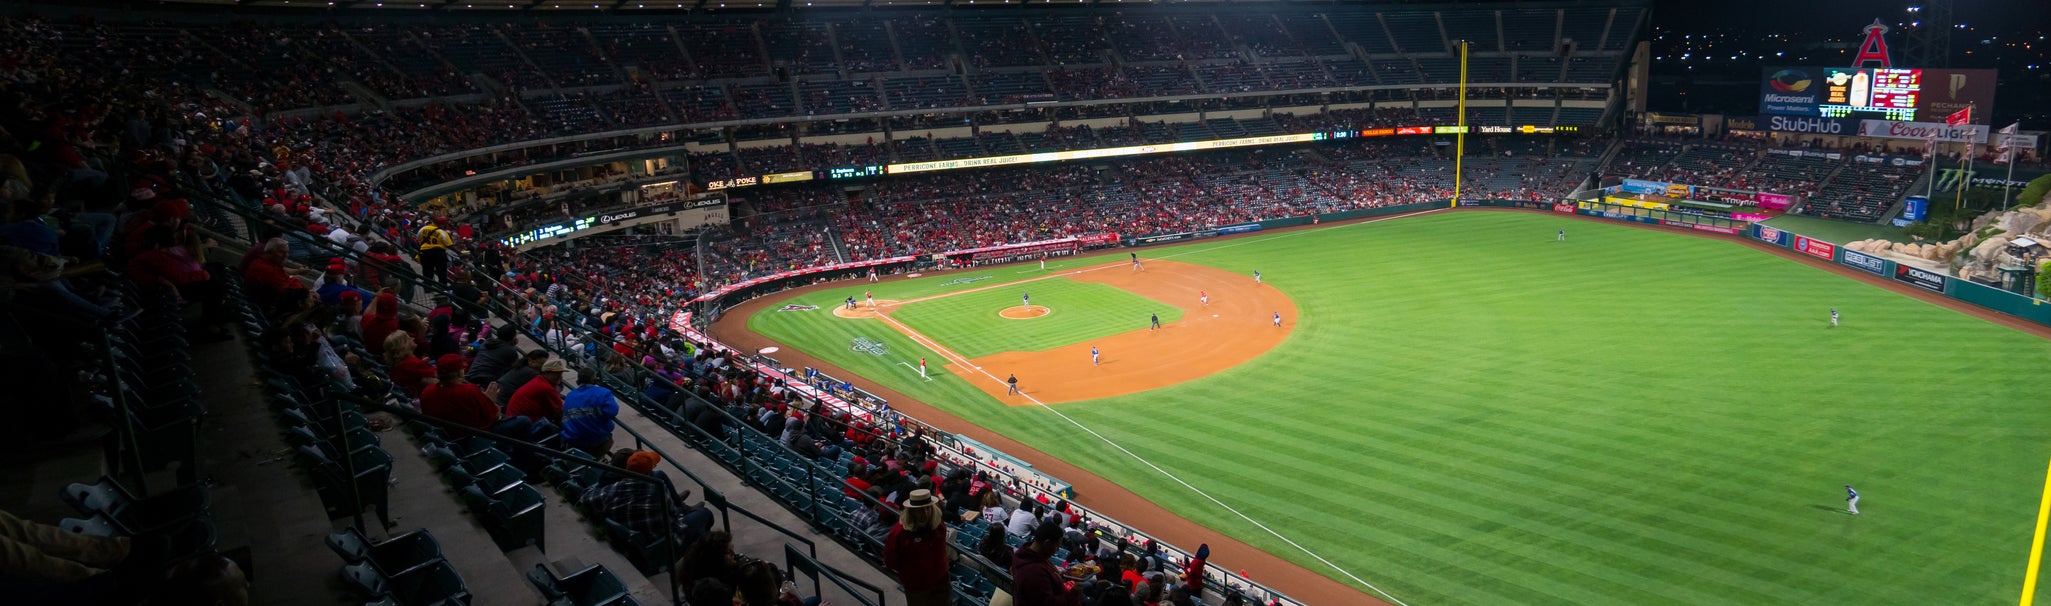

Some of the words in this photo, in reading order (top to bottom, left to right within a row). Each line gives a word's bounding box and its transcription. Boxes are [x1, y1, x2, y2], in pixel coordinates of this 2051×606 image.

[1764, 93, 1815, 104] Microsemi
[1930, 102, 1977, 110] PECHANA
[1727, 118, 1755, 130] Modelo
[1770, 116, 1841, 134] StubHub
[903, 163, 937, 171] PERRICONE
[938, 161, 958, 169] FARMS
[708, 180, 724, 188] OKE
[736, 177, 757, 185] POKE
[693, 199, 721, 207] LEXUS
[610, 212, 637, 221] LEXUS
[1907, 268, 1942, 284] YOKOHAMA
